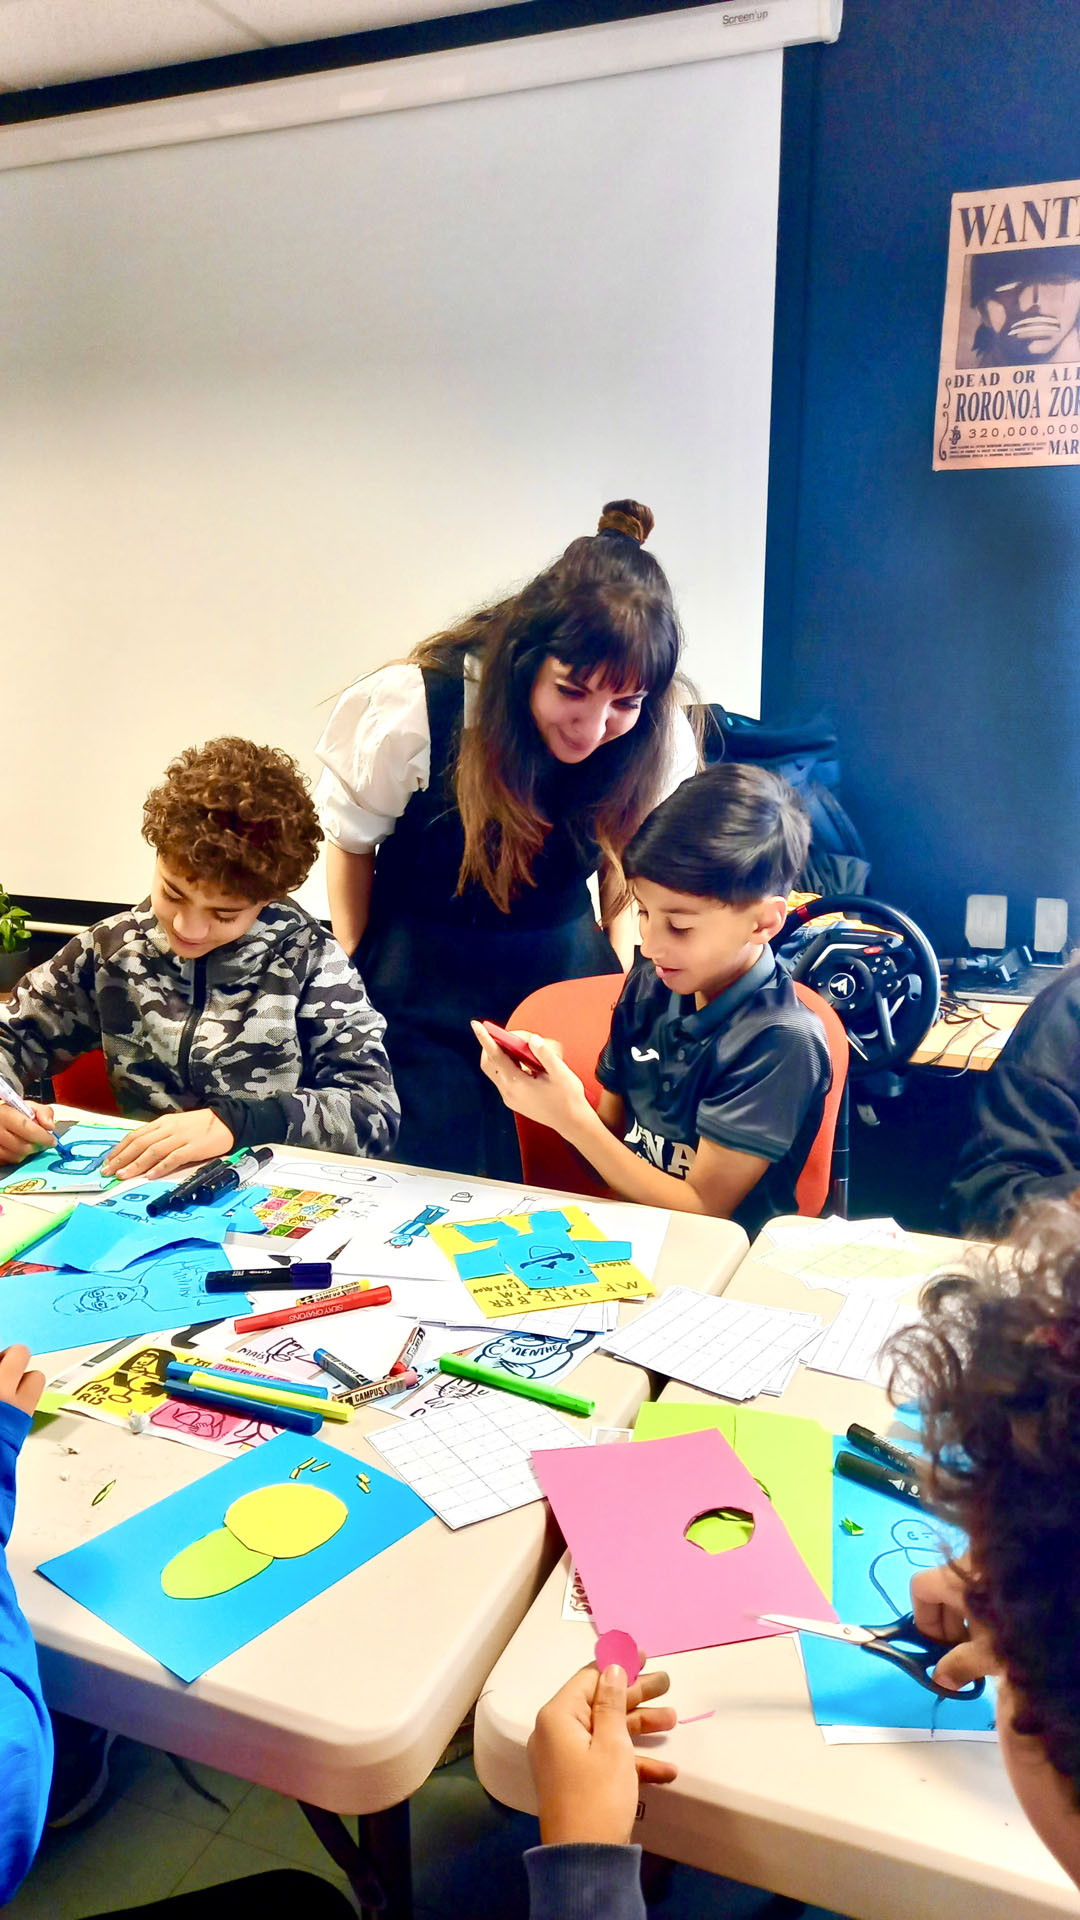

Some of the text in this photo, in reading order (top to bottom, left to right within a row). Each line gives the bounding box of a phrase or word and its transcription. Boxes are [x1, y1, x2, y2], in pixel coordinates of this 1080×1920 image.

[958, 195, 1080, 248] WANT
[954, 372, 1000, 388] DEAD
[1013, 370, 1035, 384] OR
[955, 388, 1041, 422] RORONOA
[968, 423, 1079, 439] 320,000,000
[1048, 439, 1080, 456] MAR
[354, 1386, 384, 1403] CAMPUS
